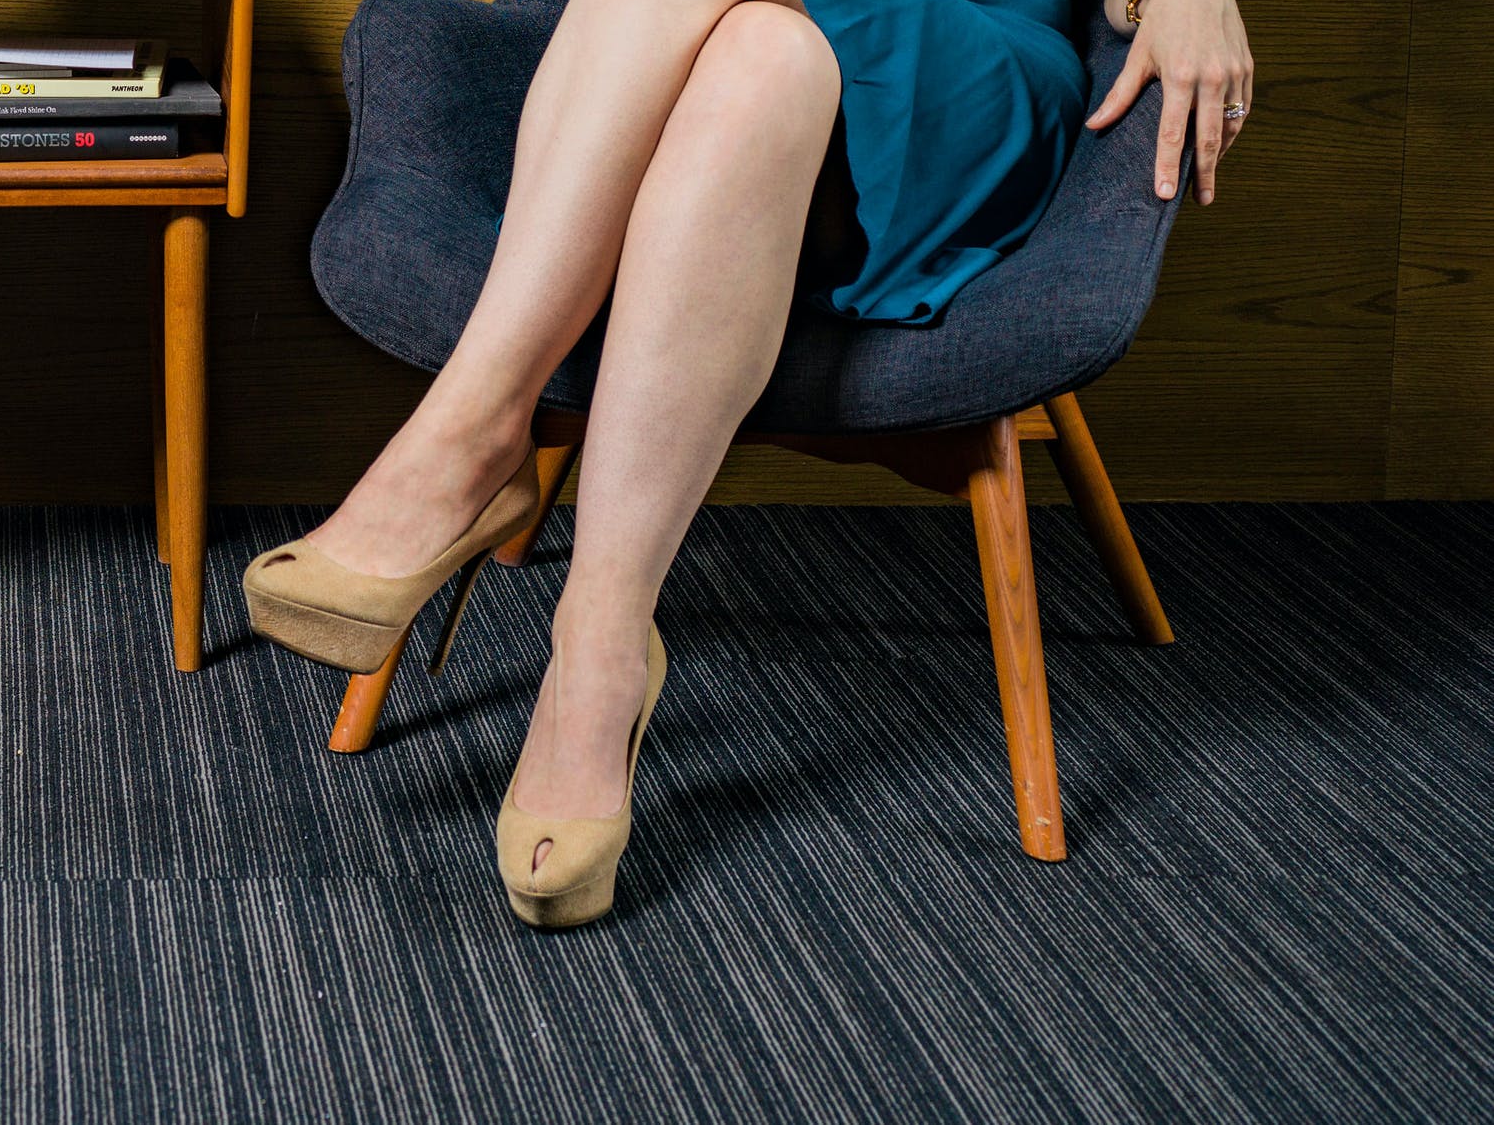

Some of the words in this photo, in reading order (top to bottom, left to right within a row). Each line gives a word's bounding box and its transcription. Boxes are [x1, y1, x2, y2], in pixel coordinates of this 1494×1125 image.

[10, 106, 27, 115] Floyd
[0, 133, 70, 148] STONES
[74, 132, 95, 148] 50
